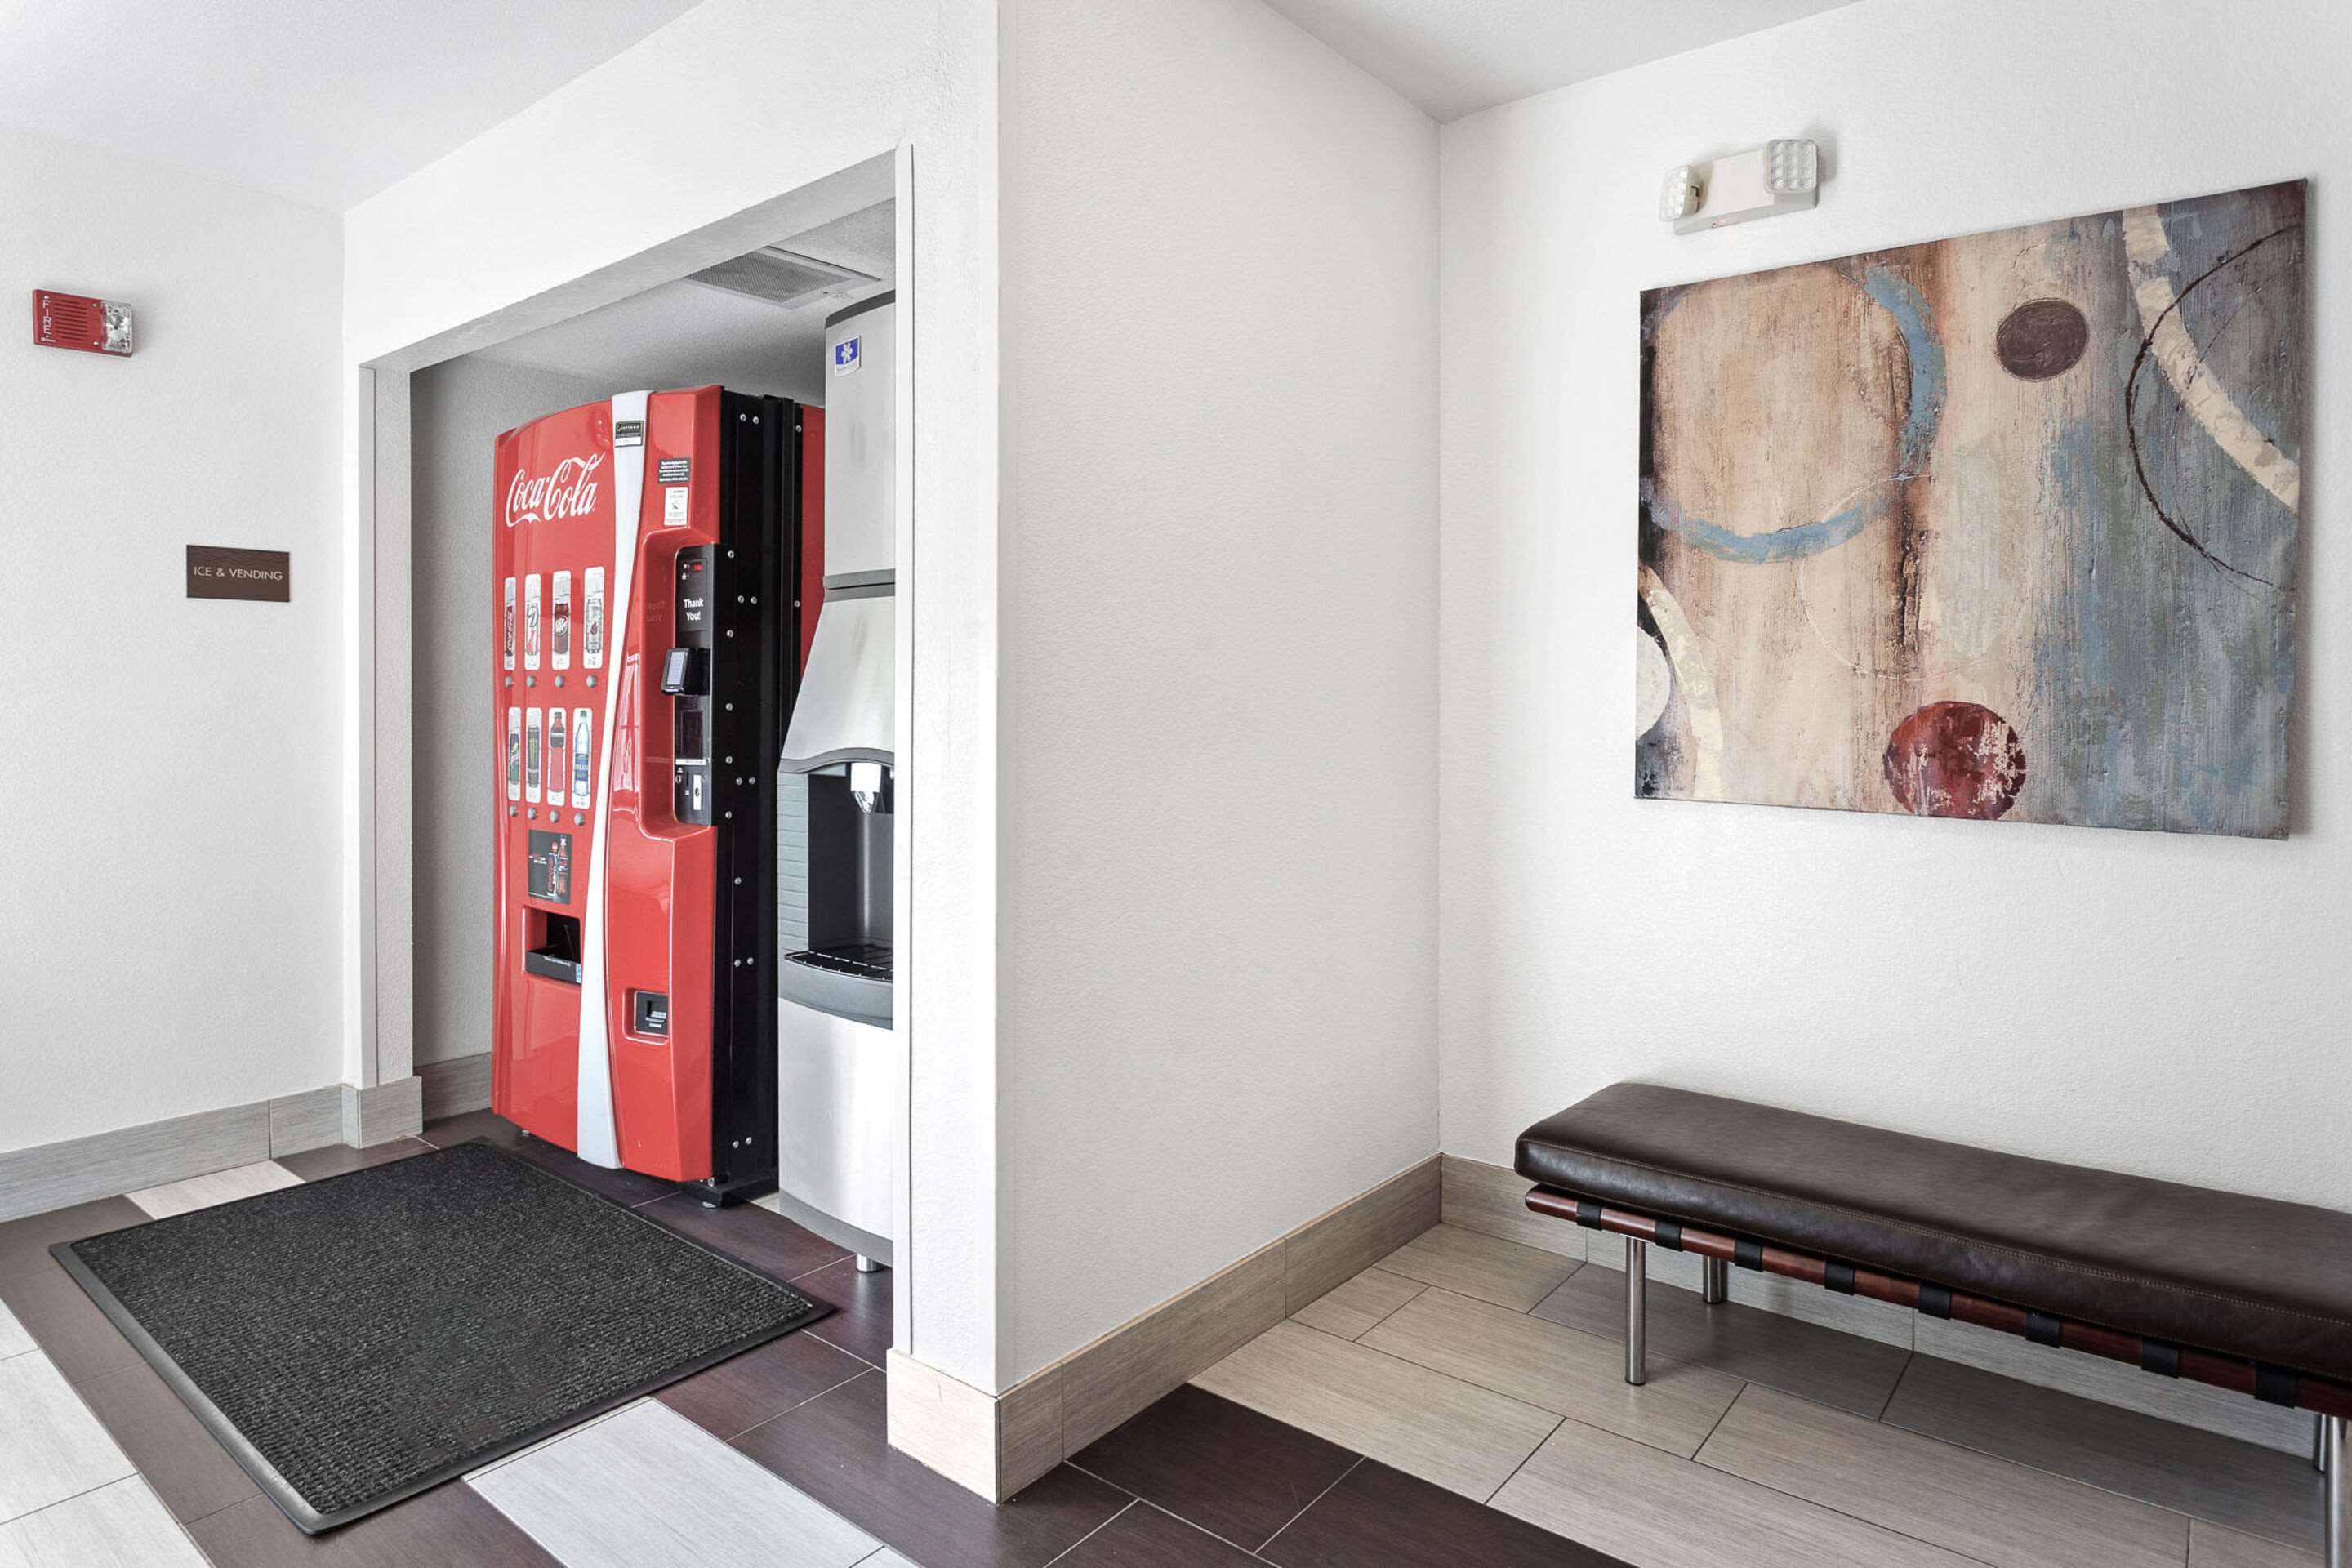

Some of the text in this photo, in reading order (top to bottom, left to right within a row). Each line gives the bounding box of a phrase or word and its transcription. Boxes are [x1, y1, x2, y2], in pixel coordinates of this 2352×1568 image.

[506, 452, 605, 528] Coca-Cola
[194, 566, 283, 581] ICE & VENDING
[683, 597, 704, 608] Thank
[686, 611, 702, 621] You!
